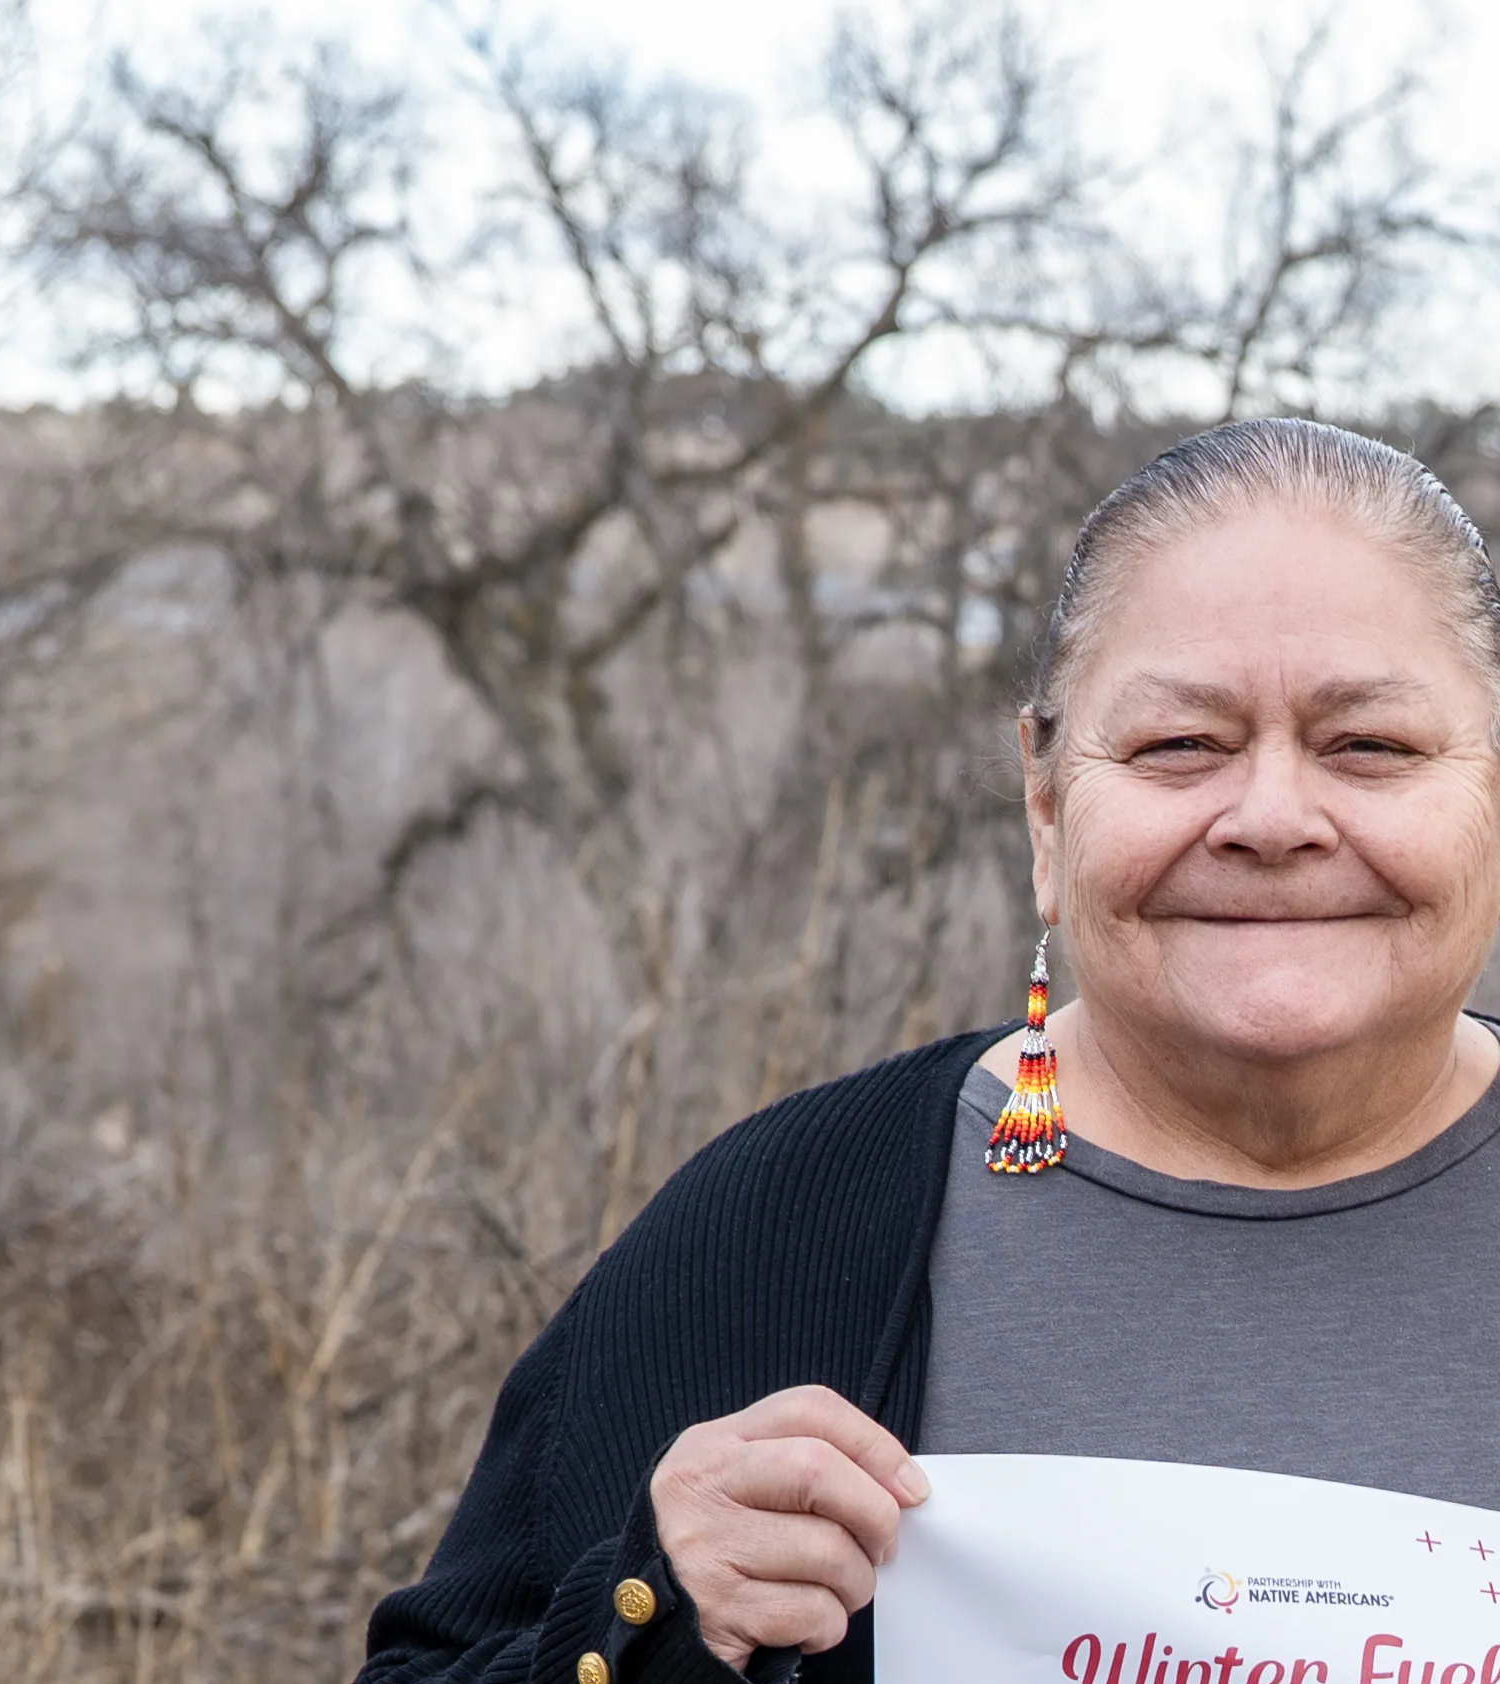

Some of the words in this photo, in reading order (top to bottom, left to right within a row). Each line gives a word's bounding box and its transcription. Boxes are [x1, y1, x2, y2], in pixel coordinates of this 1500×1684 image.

[1248, 1577, 1314, 1588] PARTNERSHIP
[1316, 1580, 1341, 1589] WITH
[1249, 1589, 1300, 1603] NATIVE
